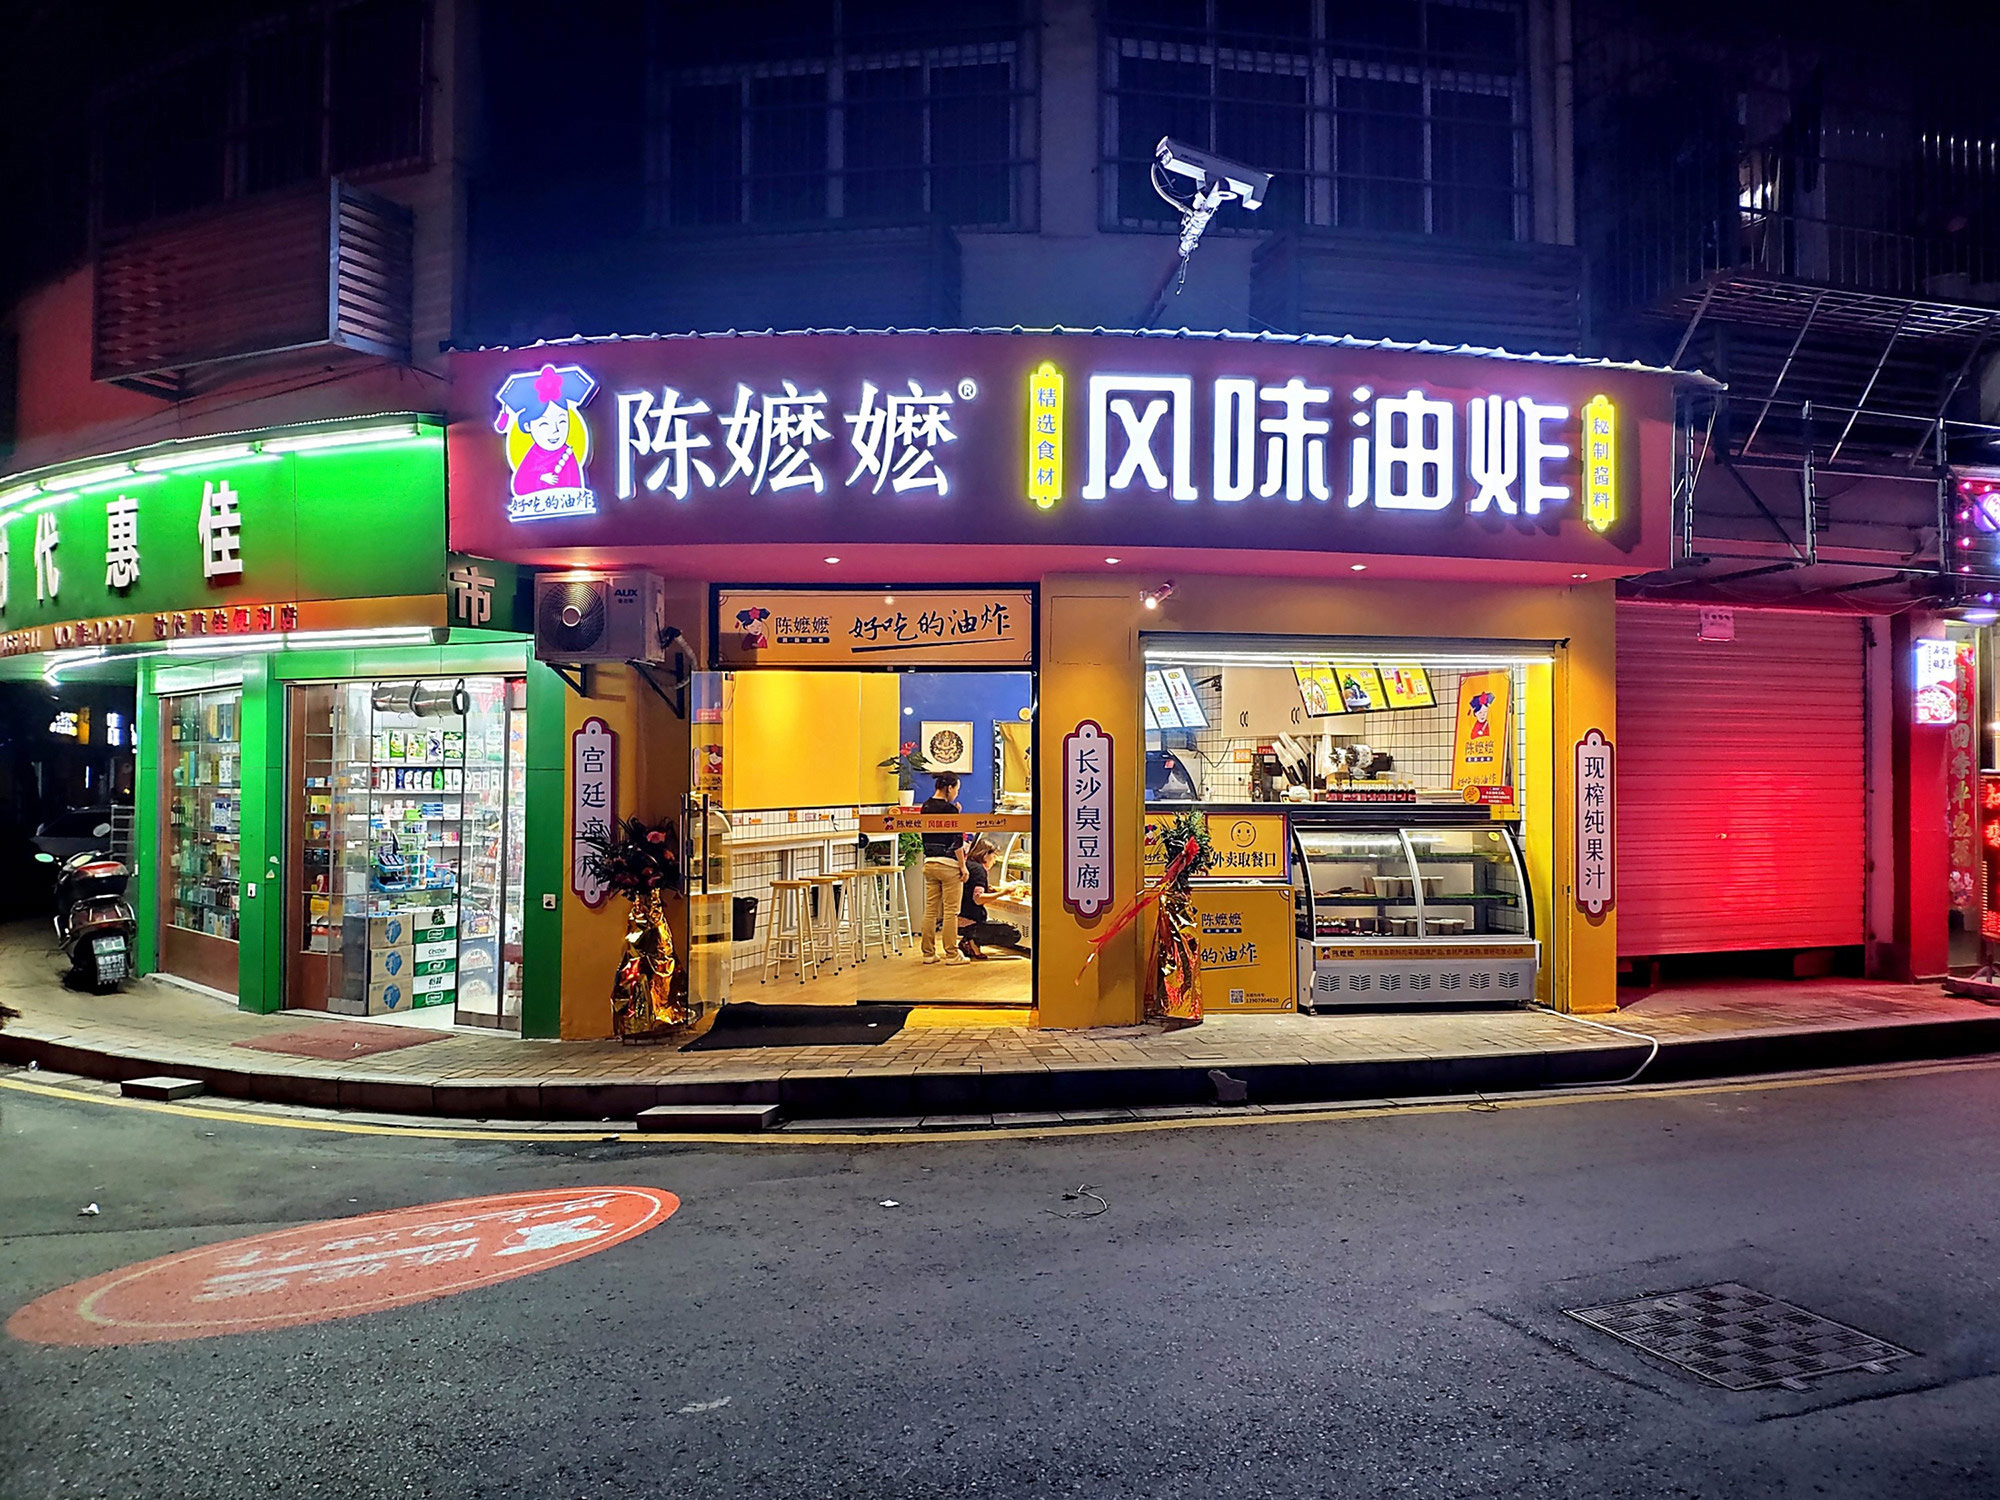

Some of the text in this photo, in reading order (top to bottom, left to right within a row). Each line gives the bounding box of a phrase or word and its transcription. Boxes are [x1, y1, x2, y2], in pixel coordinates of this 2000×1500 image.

[616, 380, 957, 501] 陈嬷嬷
[1036, 387, 1057, 486] 精选食材
[1082, 374, 1571, 517] 风味油炸
[1593, 417, 1609, 509] 秘制酱料
[511, 490, 591, 513] 好吃的油炸
[449, 566, 495, 626] 市
[614, 589, 638, 597] AUX
[775, 603, 1010, 641] 陈嬷嬷 好吃的油炸
[1075, 748, 1101, 890] 长沙臭豆腐
[1212, 851, 1276, 868] 外卖取餐口
[1584, 756, 1605, 890] 现榨纯果汁
